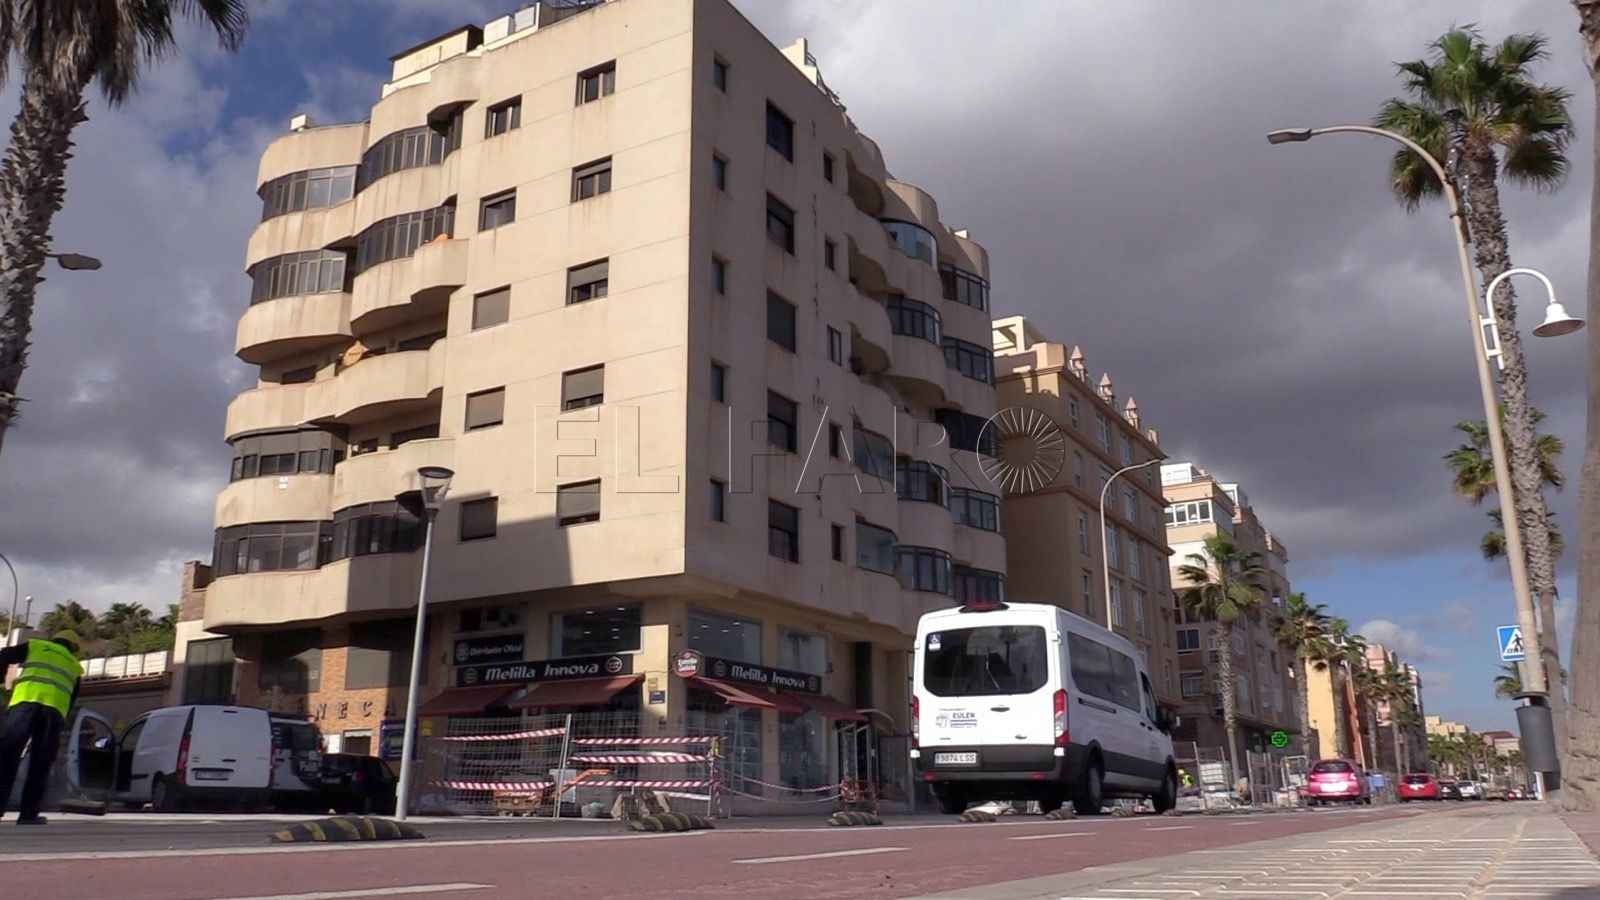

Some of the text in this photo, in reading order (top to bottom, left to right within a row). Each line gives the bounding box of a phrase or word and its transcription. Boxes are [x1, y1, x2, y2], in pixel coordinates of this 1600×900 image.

[485, 665, 536, 681] Melilla
[544, 663, 599, 677] Innova
[731, 664, 768, 682] Melilla
[772, 671, 806, 689] Innova
